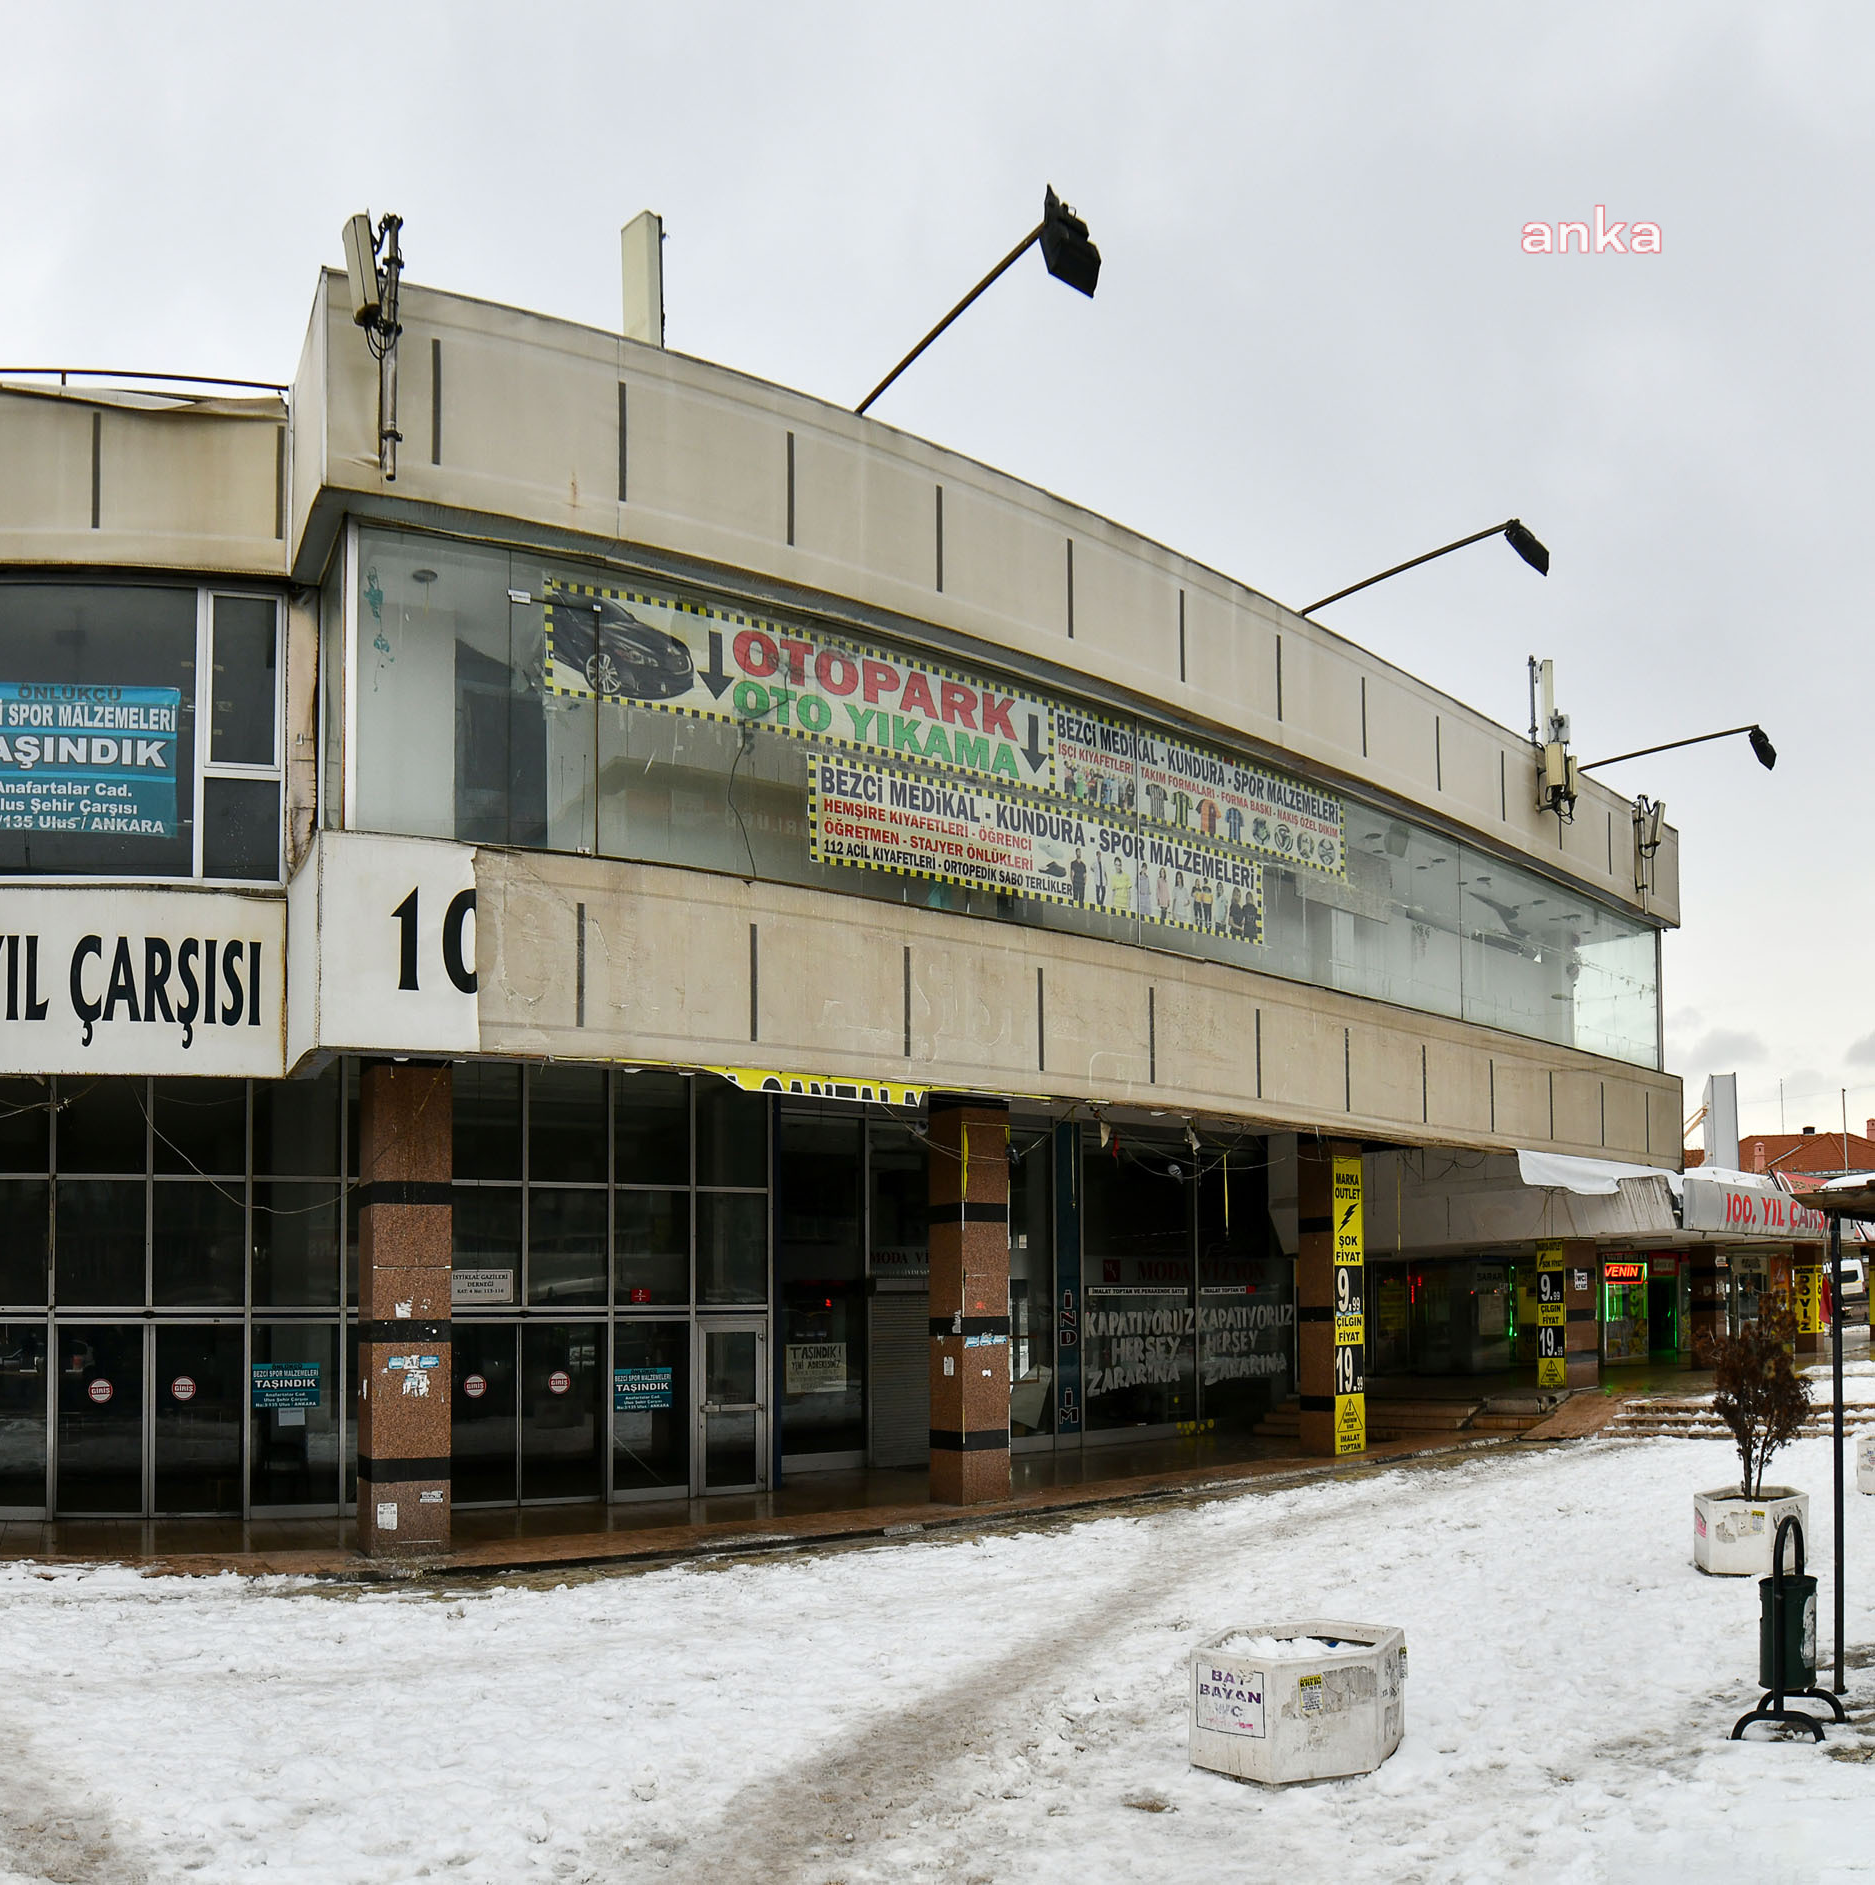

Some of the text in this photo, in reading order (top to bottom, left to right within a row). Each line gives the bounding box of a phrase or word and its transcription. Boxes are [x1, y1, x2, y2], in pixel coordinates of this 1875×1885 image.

[18, 684, 122, 704] ÖNLÜKÇÜ
[731, 628, 1020, 743] OTOPARK
[8, 703, 54, 727] SPOR
[58, 703, 175, 732] MALZEMELERİ
[731, 679, 1021, 780] OTO YIKAMA
[95, 783, 133, 798] Cad.
[1078, 748, 1272, 816] KIYAFETLERİ TAKIM FORMALARI FORMA BASKI
[1168, 747, 1225, 787] KUNDURA
[1233, 770, 1264, 797] SPOR
[1266, 782, 1339, 824] MALZEMELERİ
[30, 798, 75, 814] Şehir
[79, 800, 138, 816] Çarşısı
[39, 816, 76, 830] Ulus
[91, 818, 165, 834] ANKARA
[821, 765, 883, 803] BEZCİ
[996, 803, 1085, 847] KUNDURA
[1099, 828, 1145, 861] SPOR
[1150, 840, 1255, 890] MALZEMELERİ
[825, 798, 1032, 851] HEMŞİRE KIYAFETLERİ ÖĞRENCİ
[825, 818, 1034, 872] ÖĞRETMEN STAJYER ÖNLÜKLERİ
[824, 839, 1072, 897] 112 ACİL KIYAFETLERİ ORTOPEDİK SABO TERLİKLER
[69, 933, 263, 1050] ÇARŞISI
[1336, 1173, 1359, 1186] MARKA
[1335, 1187, 1361, 1200] OUTLET
[1726, 1193, 1785, 1227] 100. YIL
[1338, 1235, 1358, 1248] ŞOK
[1336, 1249, 1361, 1263] FİYAT
[1138, 1261, 1190, 1281] MODA
[1085, 1306, 1195, 1337] KAPATIYORUZ
[1198, 1304, 1293, 1329] KAPATIYORUZ
[1336, 1316, 1362, 1329] ÇILGIN
[1338, 1330, 1360, 1343] FİYAT
[1086, 1361, 1180, 1398] ZARARINA
[1336, 1347, 1363, 1393] 19.99
[255, 1379, 316, 1389] TAŞINDIK
[616, 1383, 669, 1392] TAŞINDIK
[1199, 1683, 1262, 1704] BAYAN
